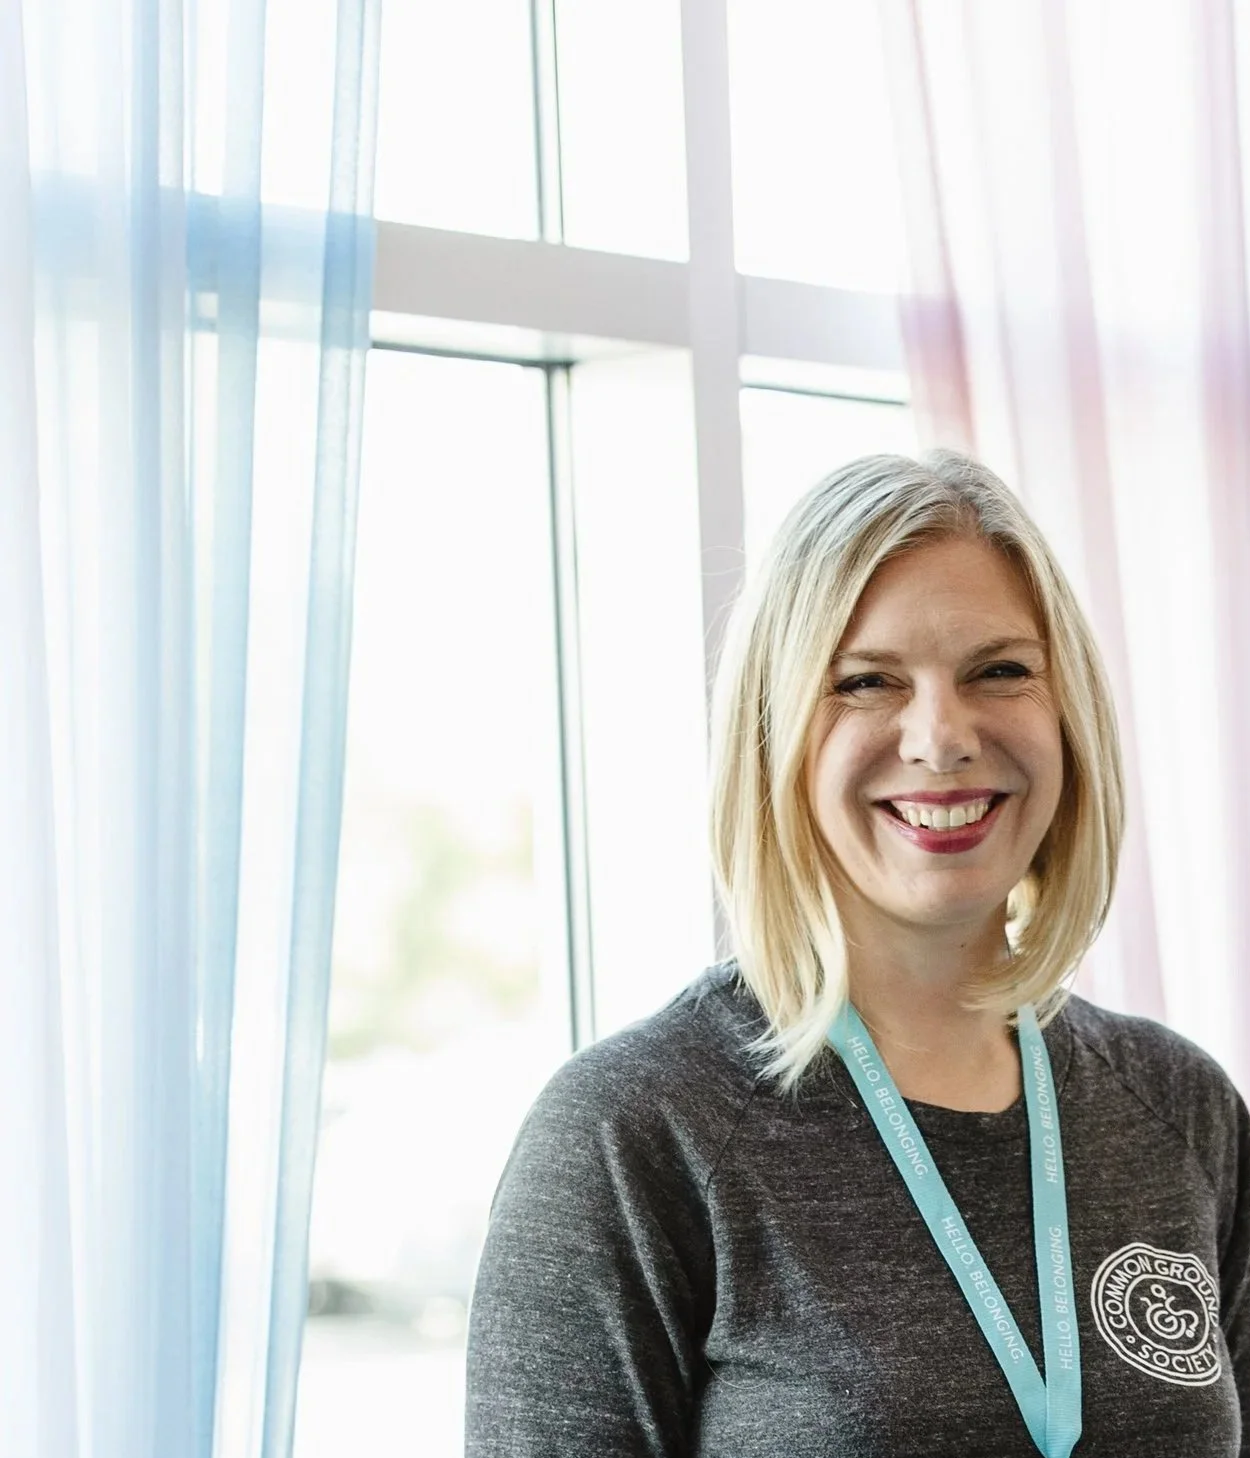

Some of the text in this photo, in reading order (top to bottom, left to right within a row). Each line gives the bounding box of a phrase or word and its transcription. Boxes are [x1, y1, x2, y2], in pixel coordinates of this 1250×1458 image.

[847, 1035, 928, 1179] HELLO. BELONGING.
[941, 1216, 1024, 1364] HELLO. BELONGING.
[1049, 1224, 1074, 1370] HELLO. BELONGING.
[1104, 1255, 1152, 1329] COMMON
[1138, 1343, 1218, 1373] SOCIETY
